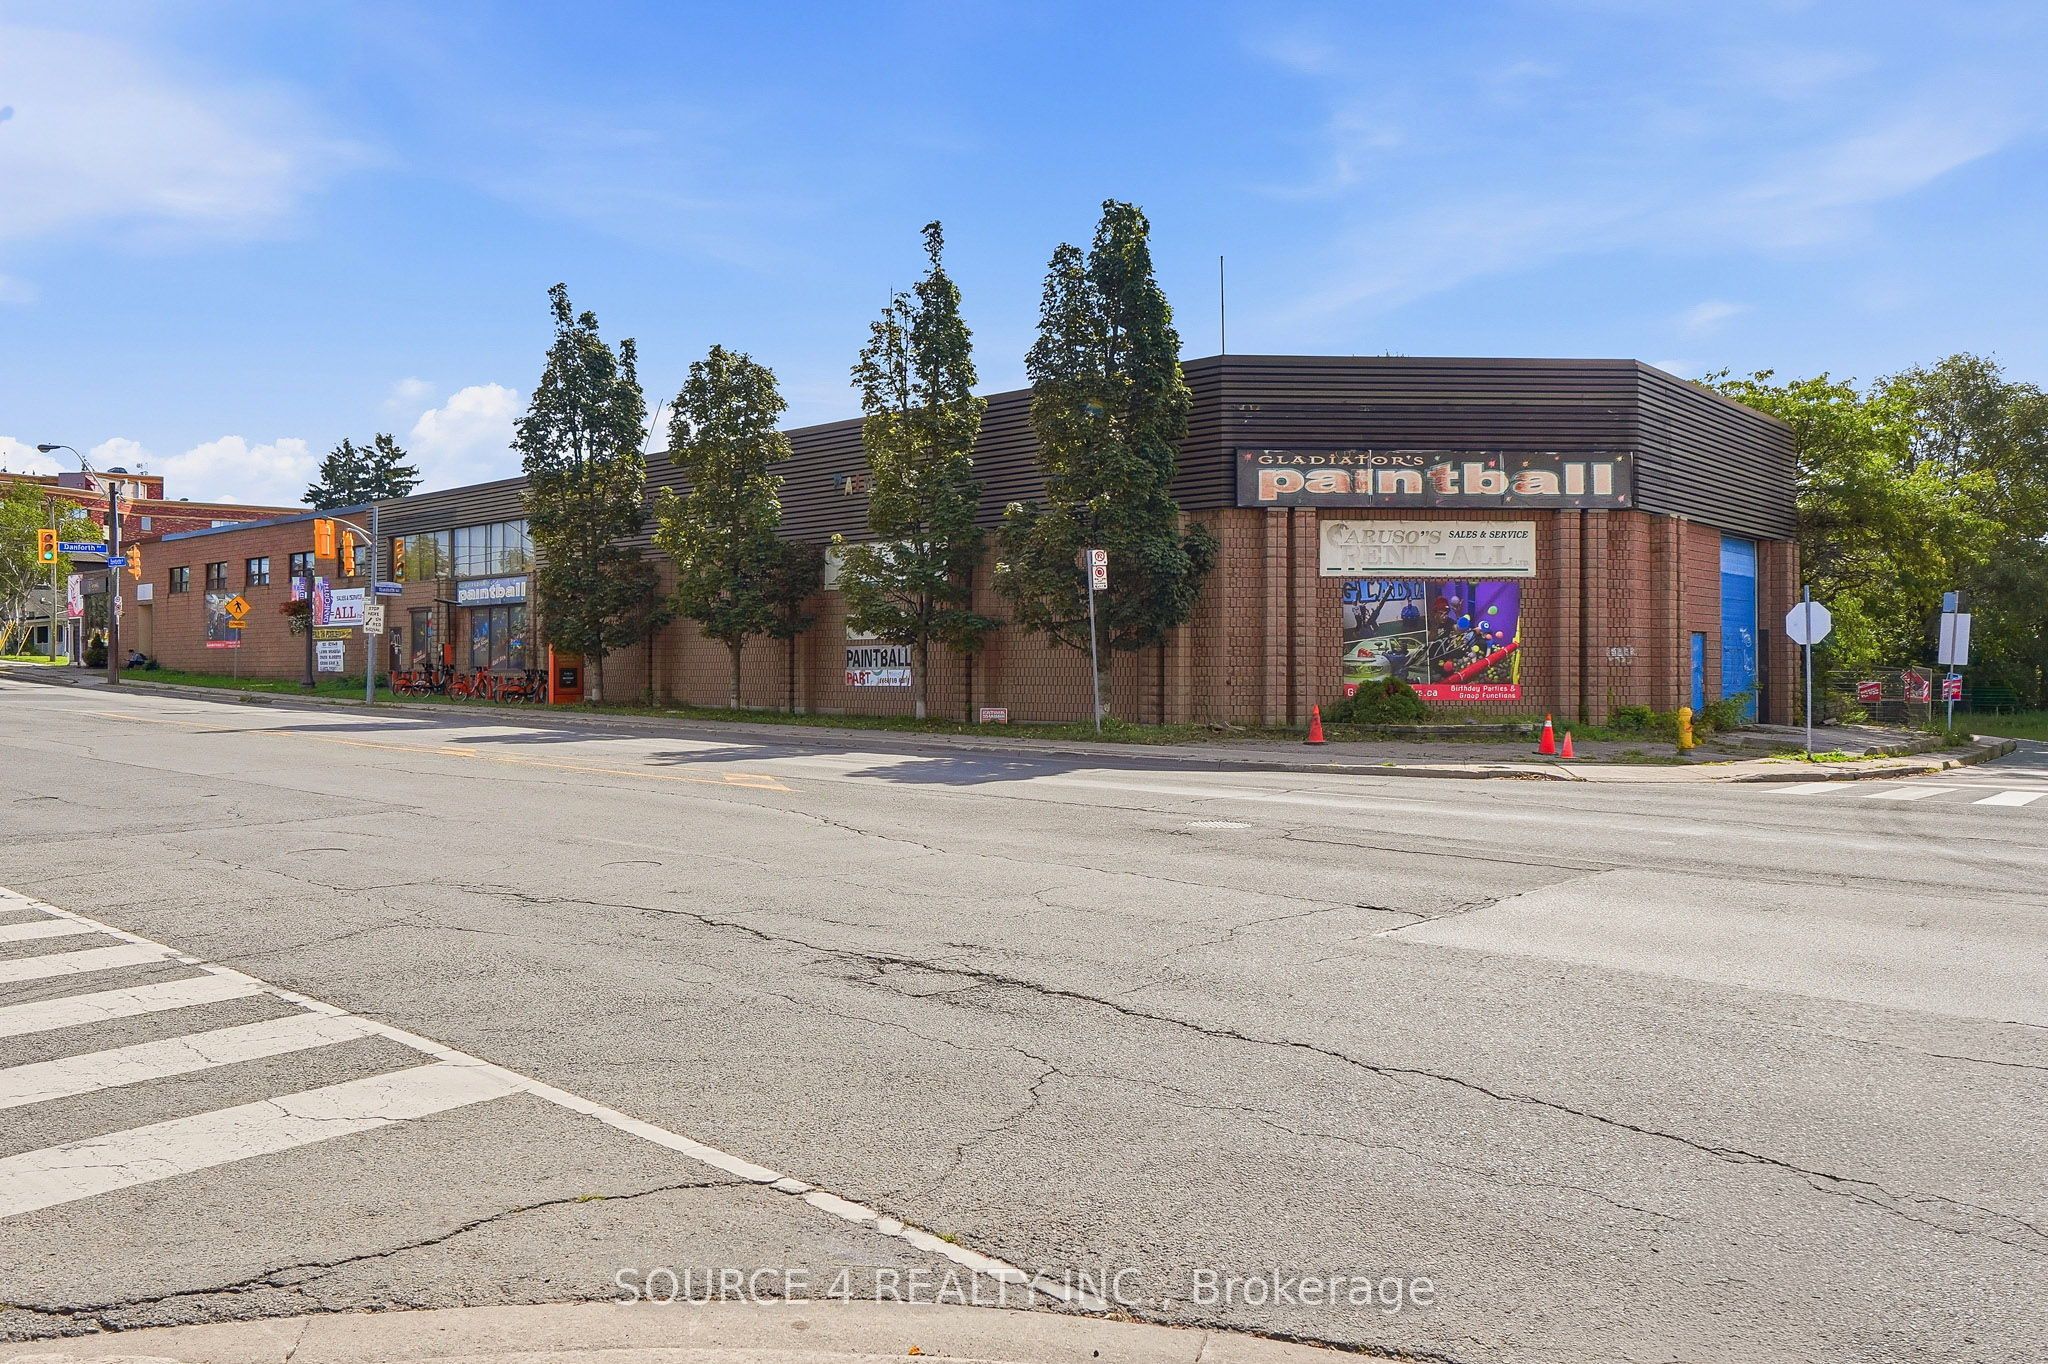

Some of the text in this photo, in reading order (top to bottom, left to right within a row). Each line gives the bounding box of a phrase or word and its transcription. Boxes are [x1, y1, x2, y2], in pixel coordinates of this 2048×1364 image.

[1258, 453, 1425, 467] GLADIATOR'S
[1257, 461, 1613, 500] paintball
[1448, 530, 1477, 539] SALES
[1480, 530, 1487, 539] &
[1489, 530, 1529, 539] SERVICE
[458, 581, 526, 603] paintball
[846, 648, 912, 668] PAINTBALL
[1450, 685, 1481, 693] Birthday
